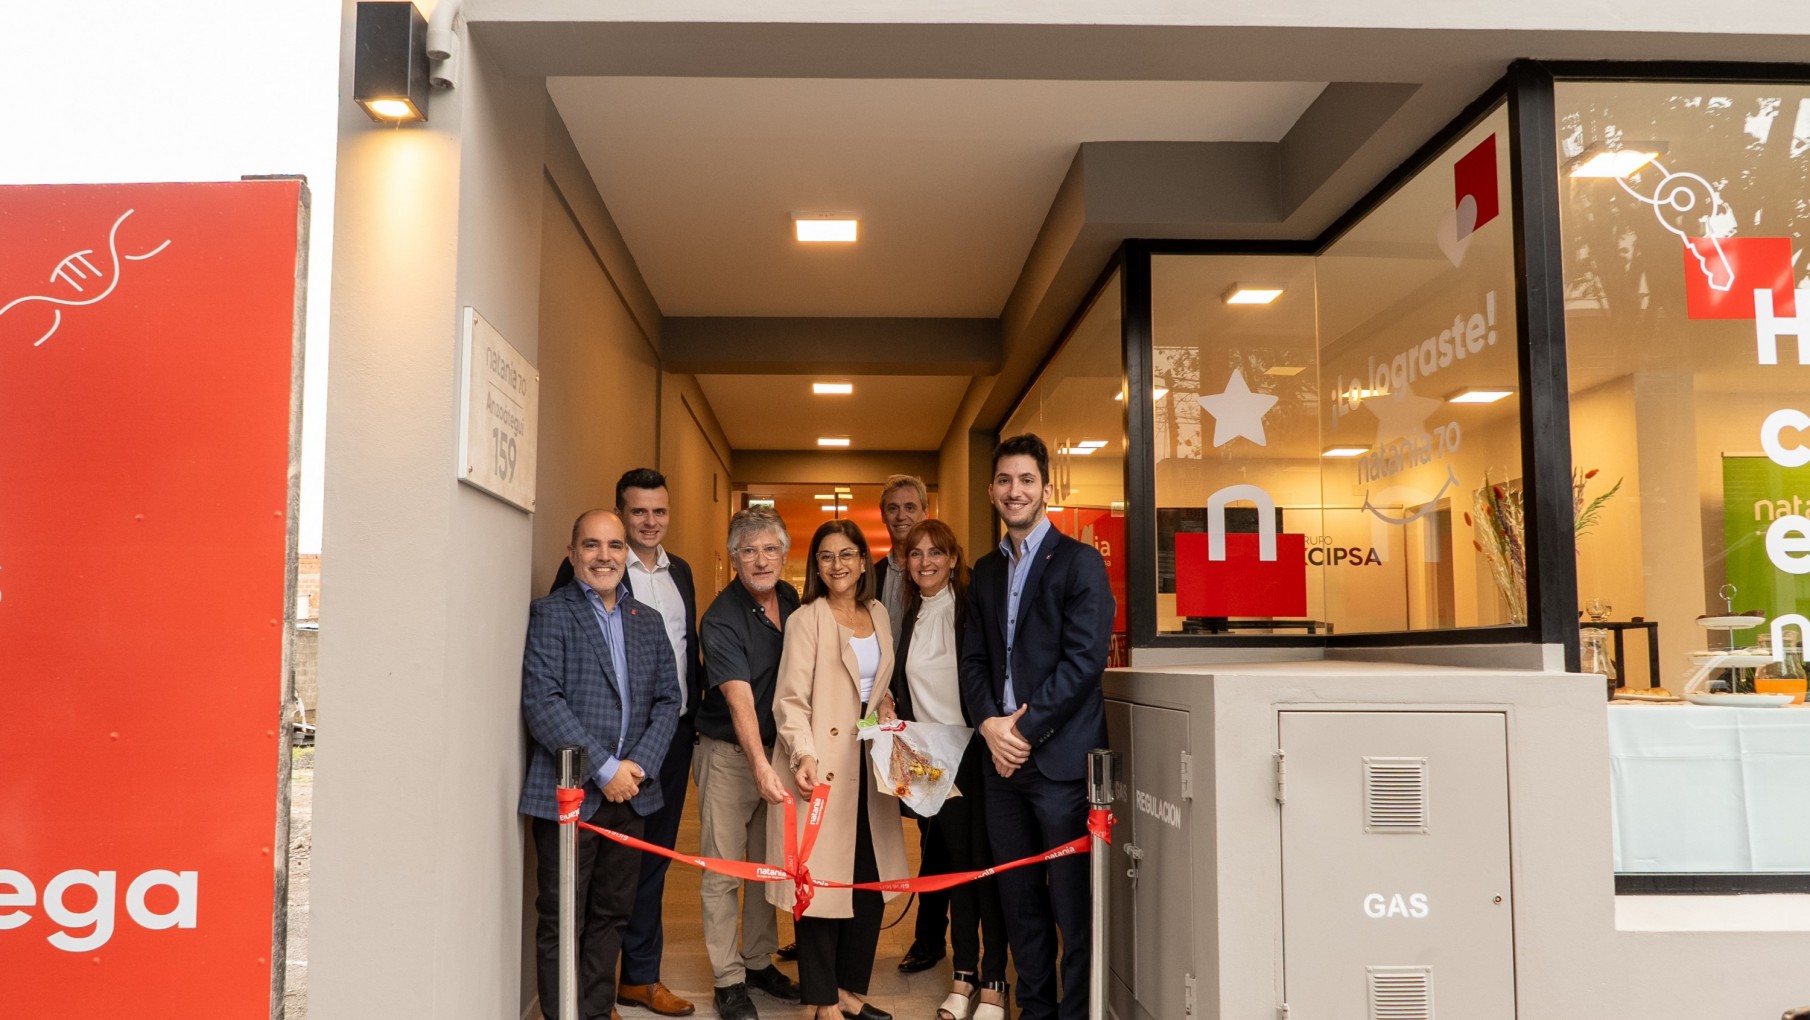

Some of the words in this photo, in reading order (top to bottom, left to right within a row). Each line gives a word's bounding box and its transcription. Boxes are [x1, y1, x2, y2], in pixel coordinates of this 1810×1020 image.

[1368, 290, 1497, 400] lograste!
[486, 347, 517, 391] natania
[518, 373, 527, 397] 70
[492, 427, 517, 484] 159
[1358, 424, 1432, 485] natania
[1434, 421, 1461, 459] 70
[1305, 547, 1382, 566] CIPSA
[1115, 781, 1128, 803] GAS
[1136, 789, 1181, 830] REGULACION
[756, 867, 787, 877] natania
[0, 868, 199, 952] ega
[1363, 892, 1429, 919] GAS
